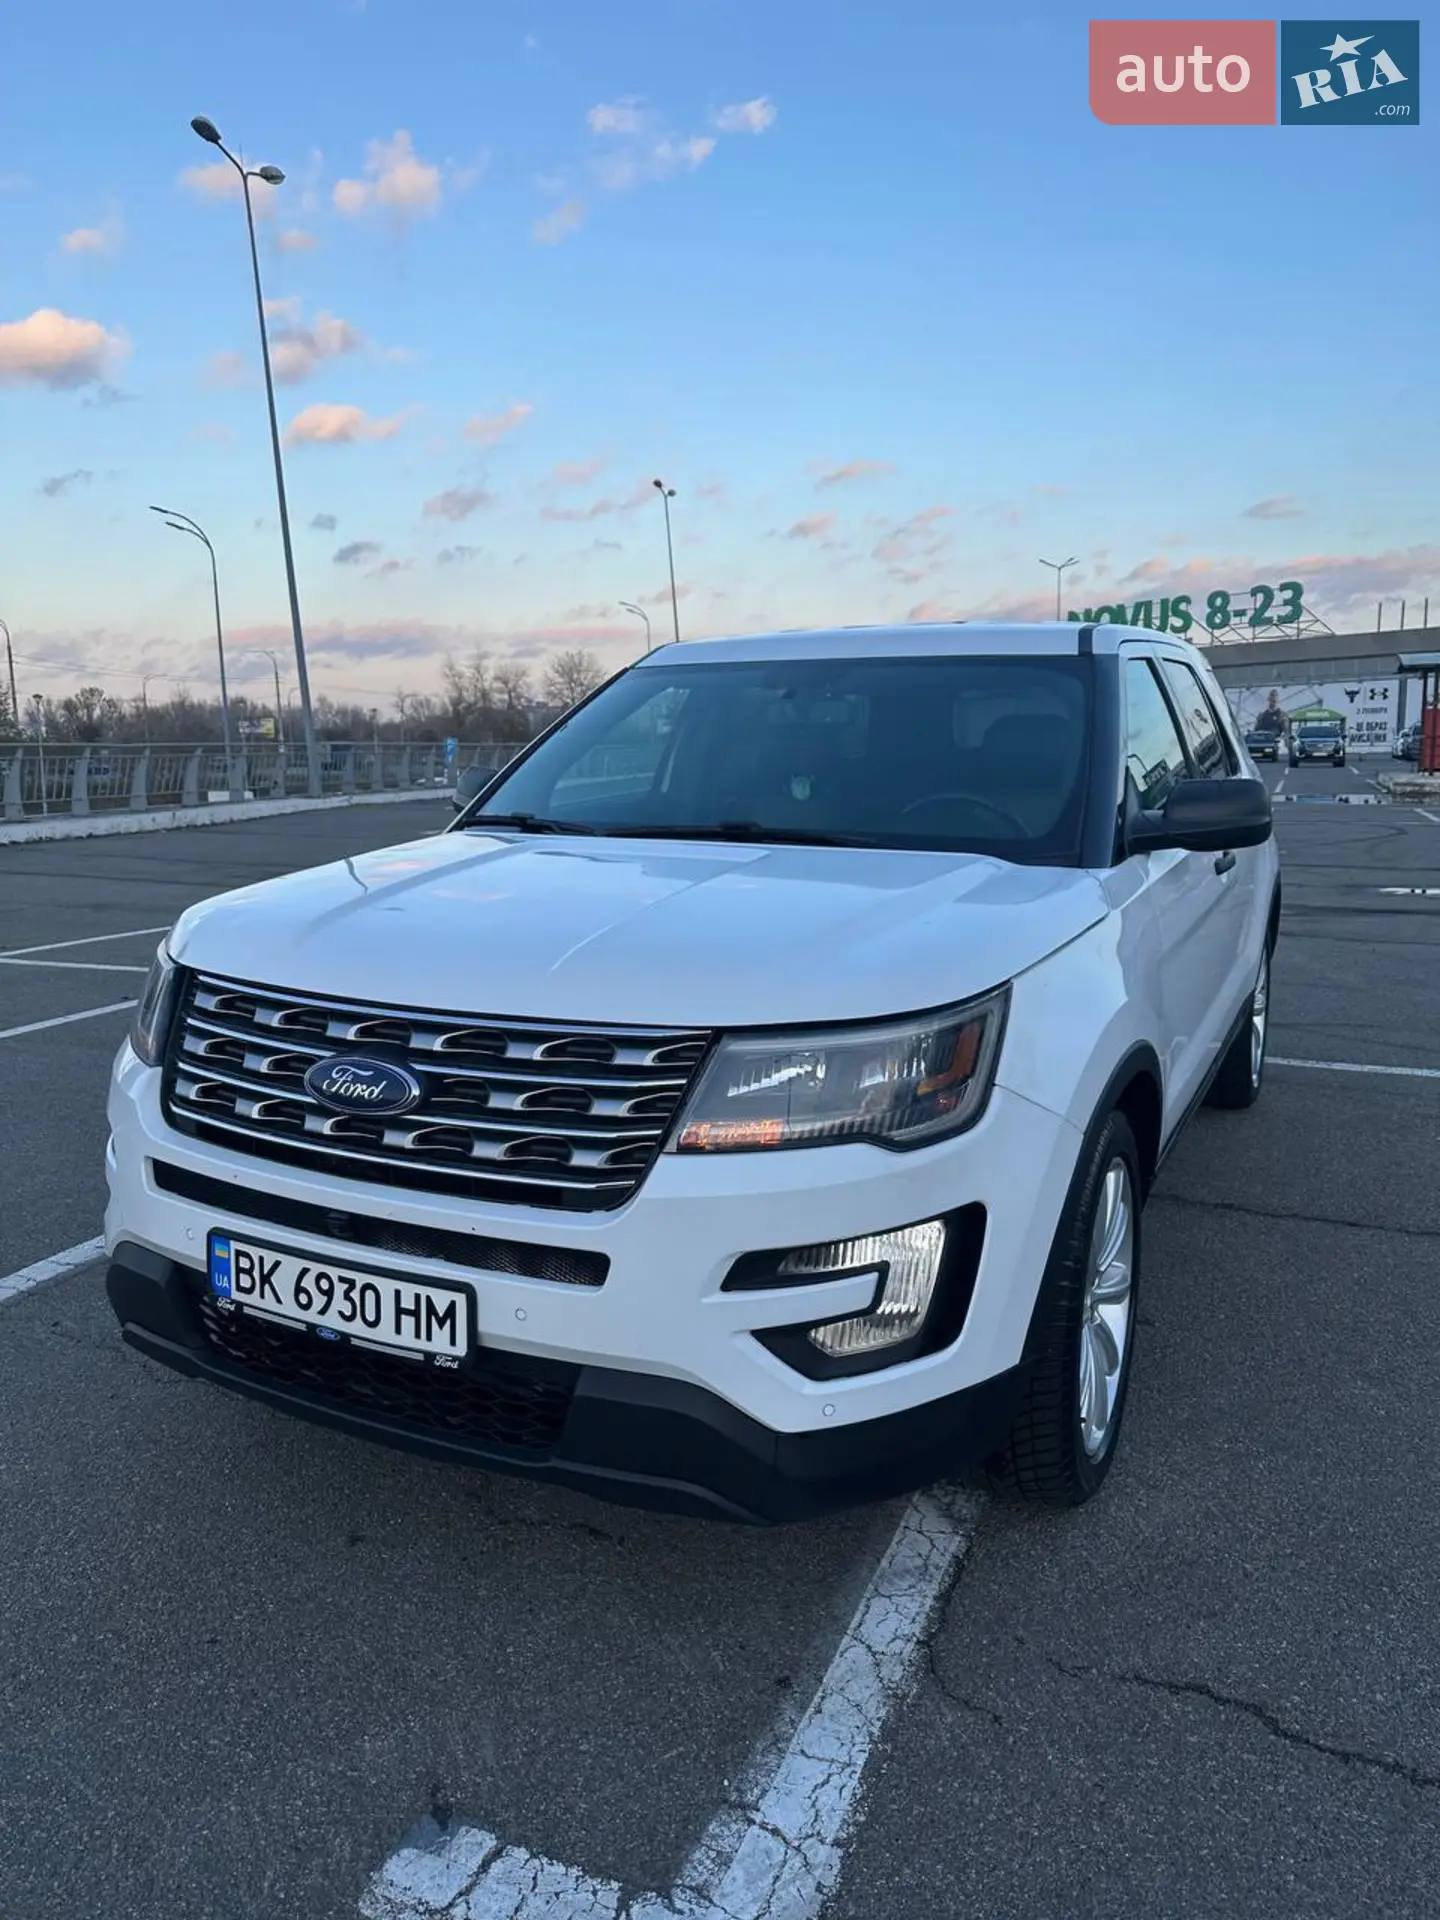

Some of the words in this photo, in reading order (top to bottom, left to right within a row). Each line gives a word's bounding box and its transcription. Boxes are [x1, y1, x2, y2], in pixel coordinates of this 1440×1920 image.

[1205, 581, 1304, 630] 8-23
[322, 1065, 387, 1101] Ford
[215, 1272, 230, 1288] UA
[216, 1296, 236, 1312] Ford
[234, 1249, 283, 1305] BK
[294, 1267, 381, 1329] 6930
[394, 1289, 457, 1347] HM
[433, 1355, 459, 1369] Ford
